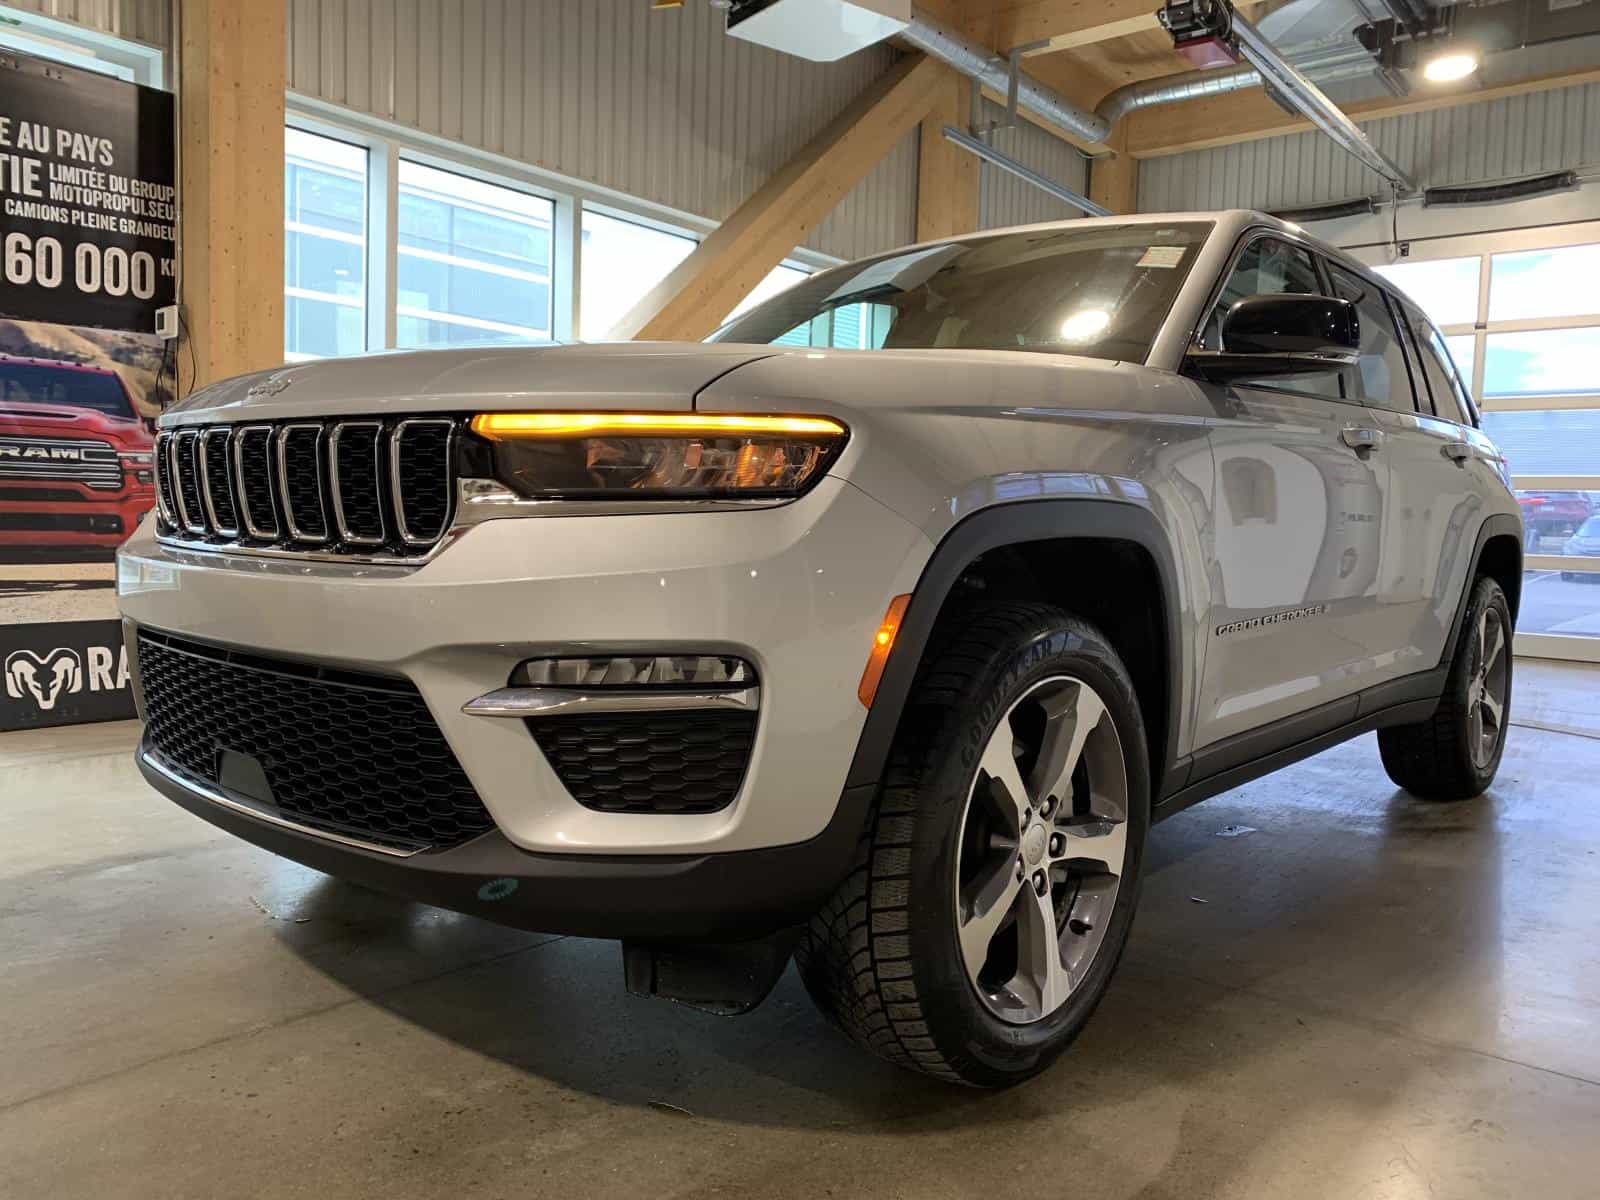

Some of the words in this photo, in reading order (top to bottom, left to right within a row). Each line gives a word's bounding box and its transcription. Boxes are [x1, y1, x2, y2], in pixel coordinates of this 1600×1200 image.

[17, 121, 49, 153] AU
[56, 129, 113, 166] PAYS
[50, 162, 106, 190] LIMITÉE
[109, 174, 128, 194] DU
[5, 199, 69, 224] CAMIONS
[72, 210, 117, 232] PLEINE
[0, 232, 63, 288] 60
[75, 242, 155, 300] 000
[0, 447, 79, 459] RAM
[1216, 618, 1260, 636] GRAND
[1261, 605, 1326, 626] CHEROKEE
